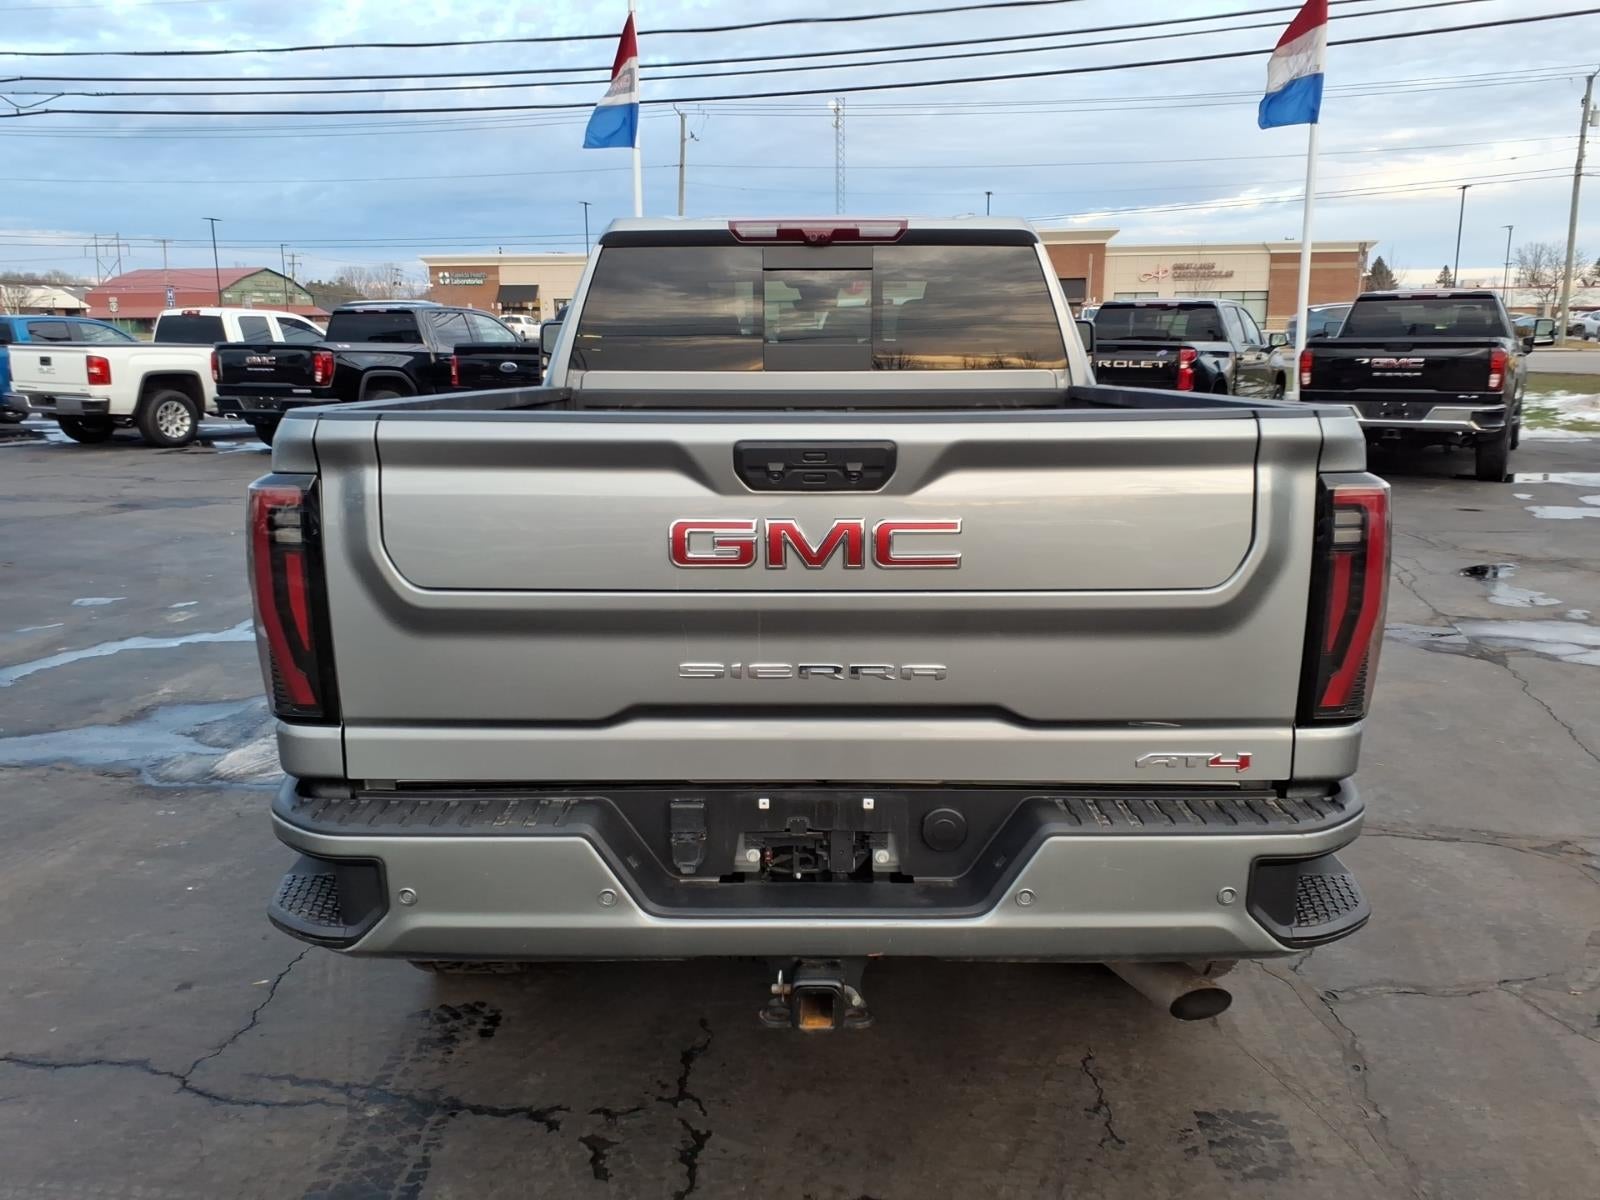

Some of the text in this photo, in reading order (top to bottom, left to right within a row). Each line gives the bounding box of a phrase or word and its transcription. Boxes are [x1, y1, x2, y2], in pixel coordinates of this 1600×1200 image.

[1371, 358, 1425, 368] GMC
[669, 518, 962, 569] GMC
[679, 662, 947, 681] SIERRA
[1135, 752, 1253, 773] AT4
